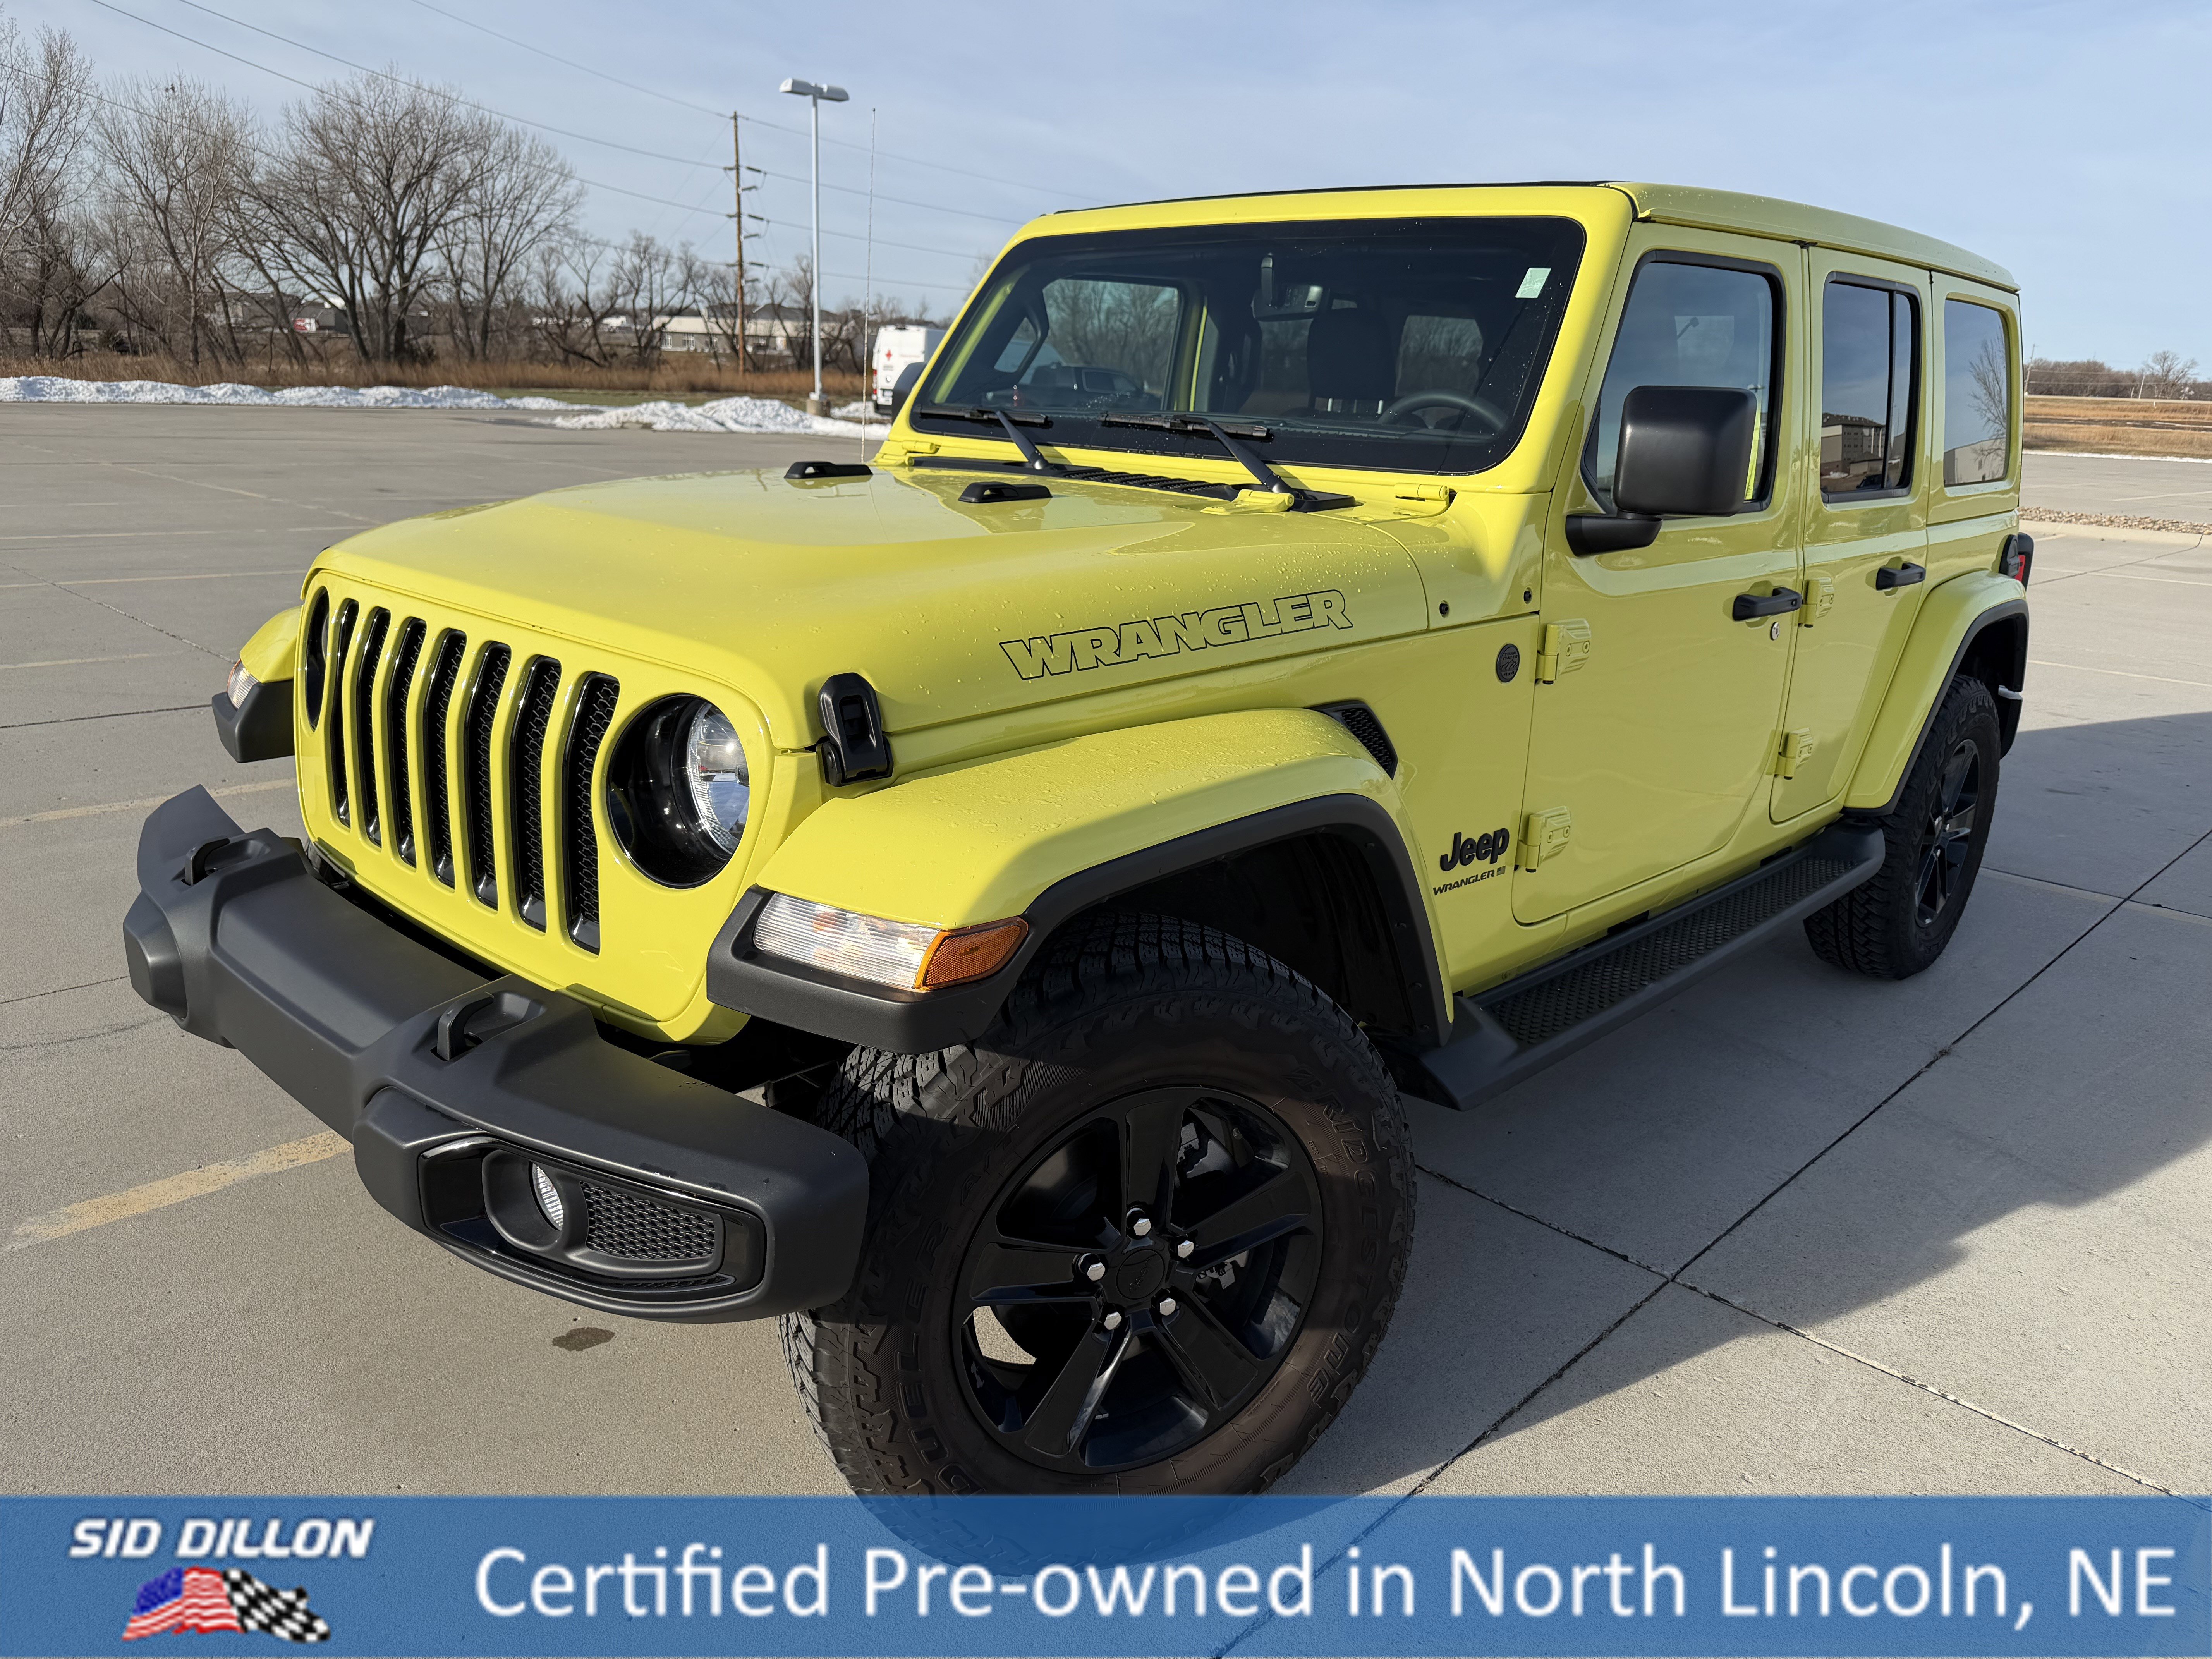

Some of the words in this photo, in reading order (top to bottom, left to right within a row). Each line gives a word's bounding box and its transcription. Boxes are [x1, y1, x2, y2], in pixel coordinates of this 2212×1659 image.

[999, 589, 1353, 680] WRANGLER
[1432, 869, 1495, 896] WRANGLER
[1439, 827, 1510, 872] Jeep
[1281, 1063, 1382, 1408] BRIDGESTONE
